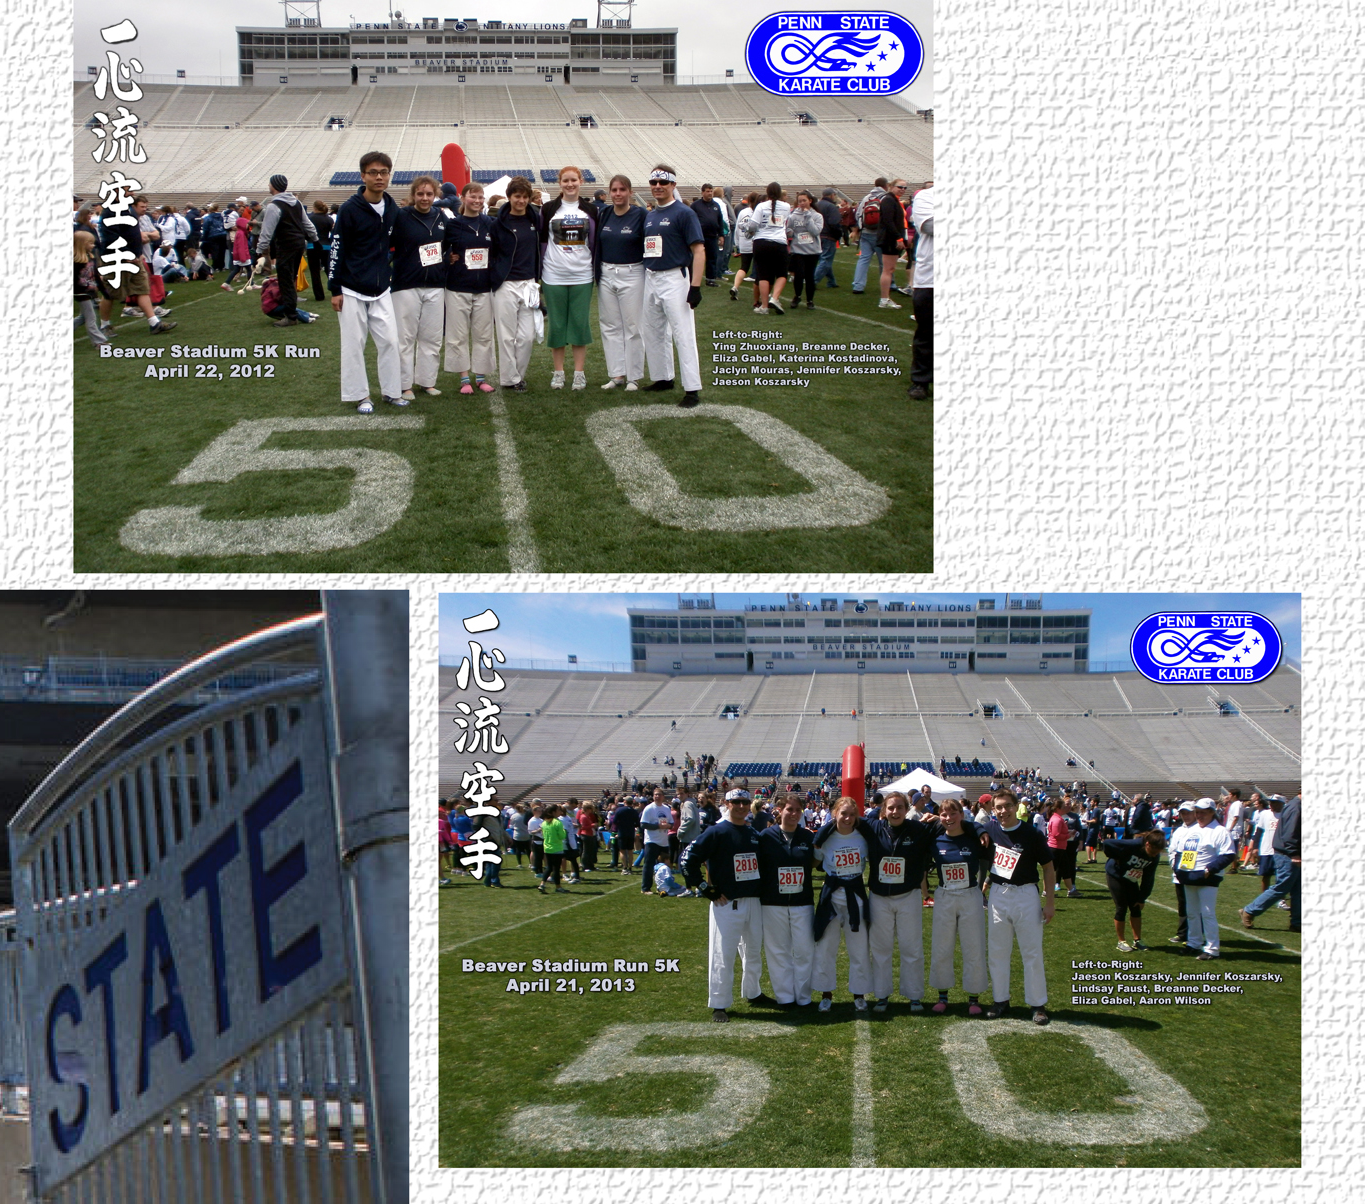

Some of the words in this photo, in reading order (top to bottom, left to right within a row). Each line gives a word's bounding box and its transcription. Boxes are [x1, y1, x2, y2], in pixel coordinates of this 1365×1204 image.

[735, 858, 758, 873] 2818
[835, 852, 860, 867] 2383
[46, 757, 324, 1155] STATE
